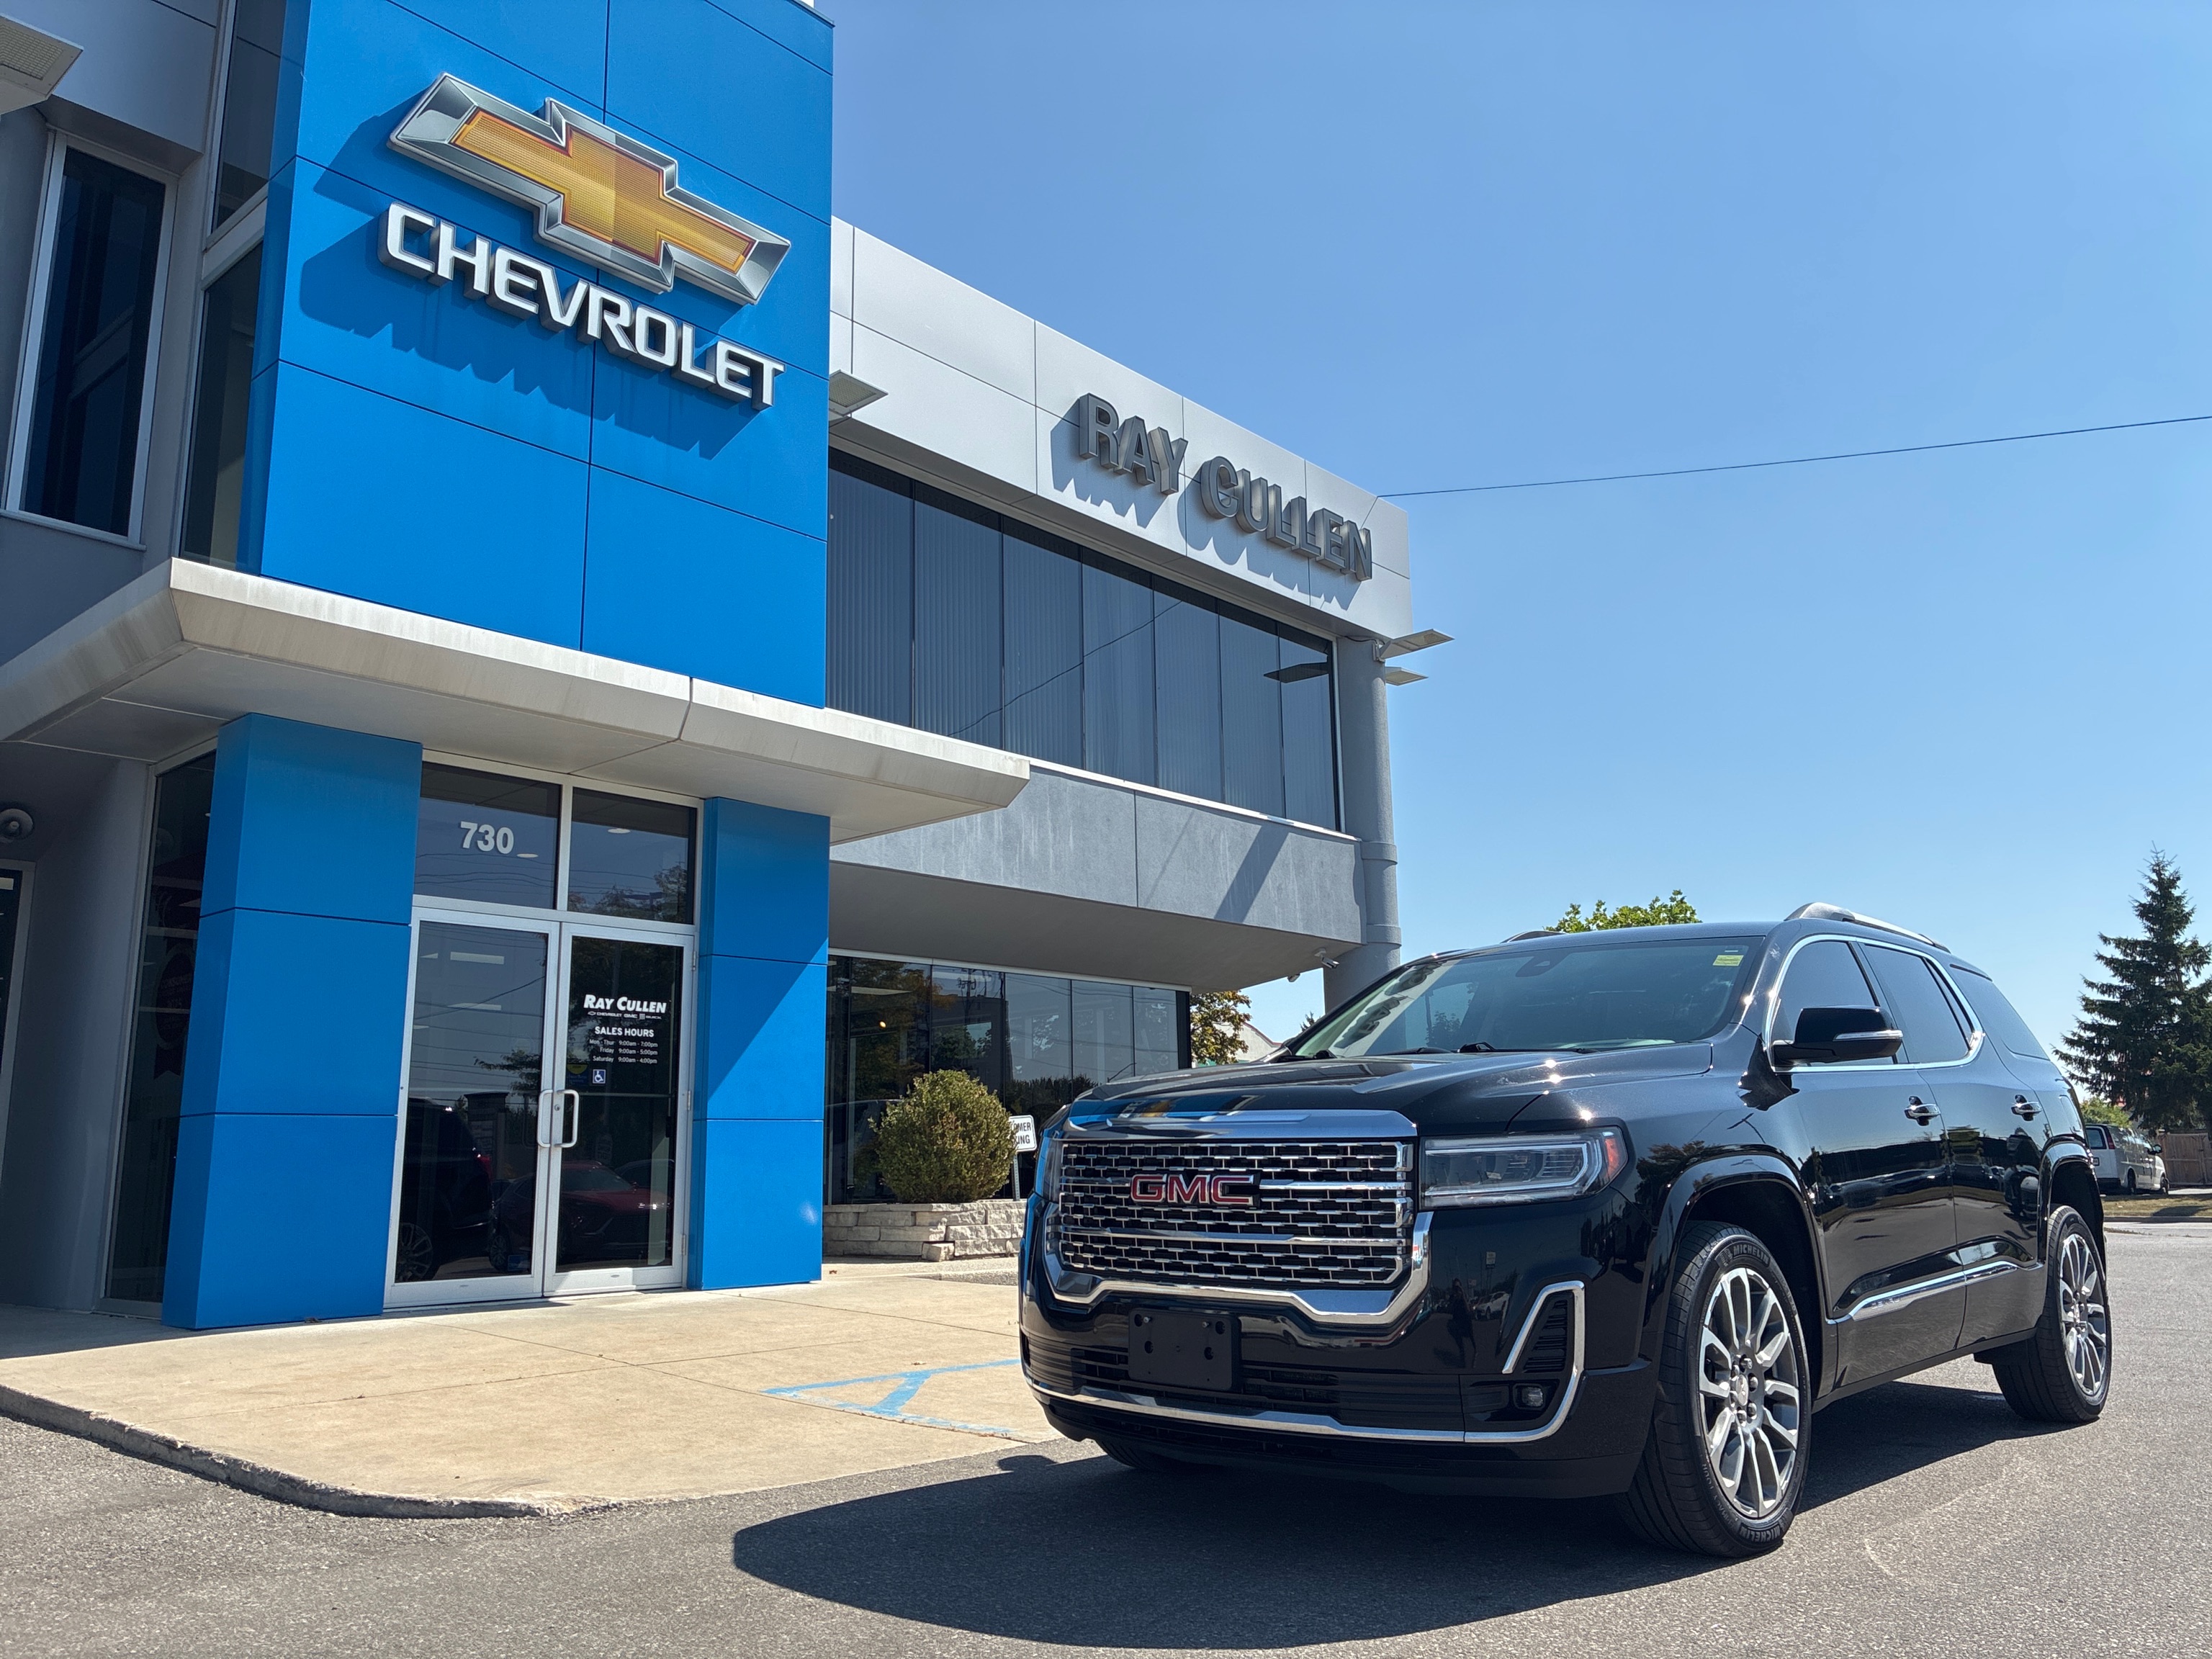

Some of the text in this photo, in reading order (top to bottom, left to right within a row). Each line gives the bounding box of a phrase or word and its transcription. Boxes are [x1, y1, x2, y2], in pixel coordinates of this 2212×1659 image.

[377, 201, 786, 410] CHEVROLET
[1079, 392, 1372, 581] RAY CULLEN
[460, 820, 515, 854] 730
[583, 994, 667, 1013] RAY CULLEN
[595, 1026, 654, 1037] SALES HOURS
[1130, 1173, 1254, 1205] GMC
[1732, 1244, 1770, 1265] MICHELIN
[1740, 1525, 1781, 1542] MICHELIN
